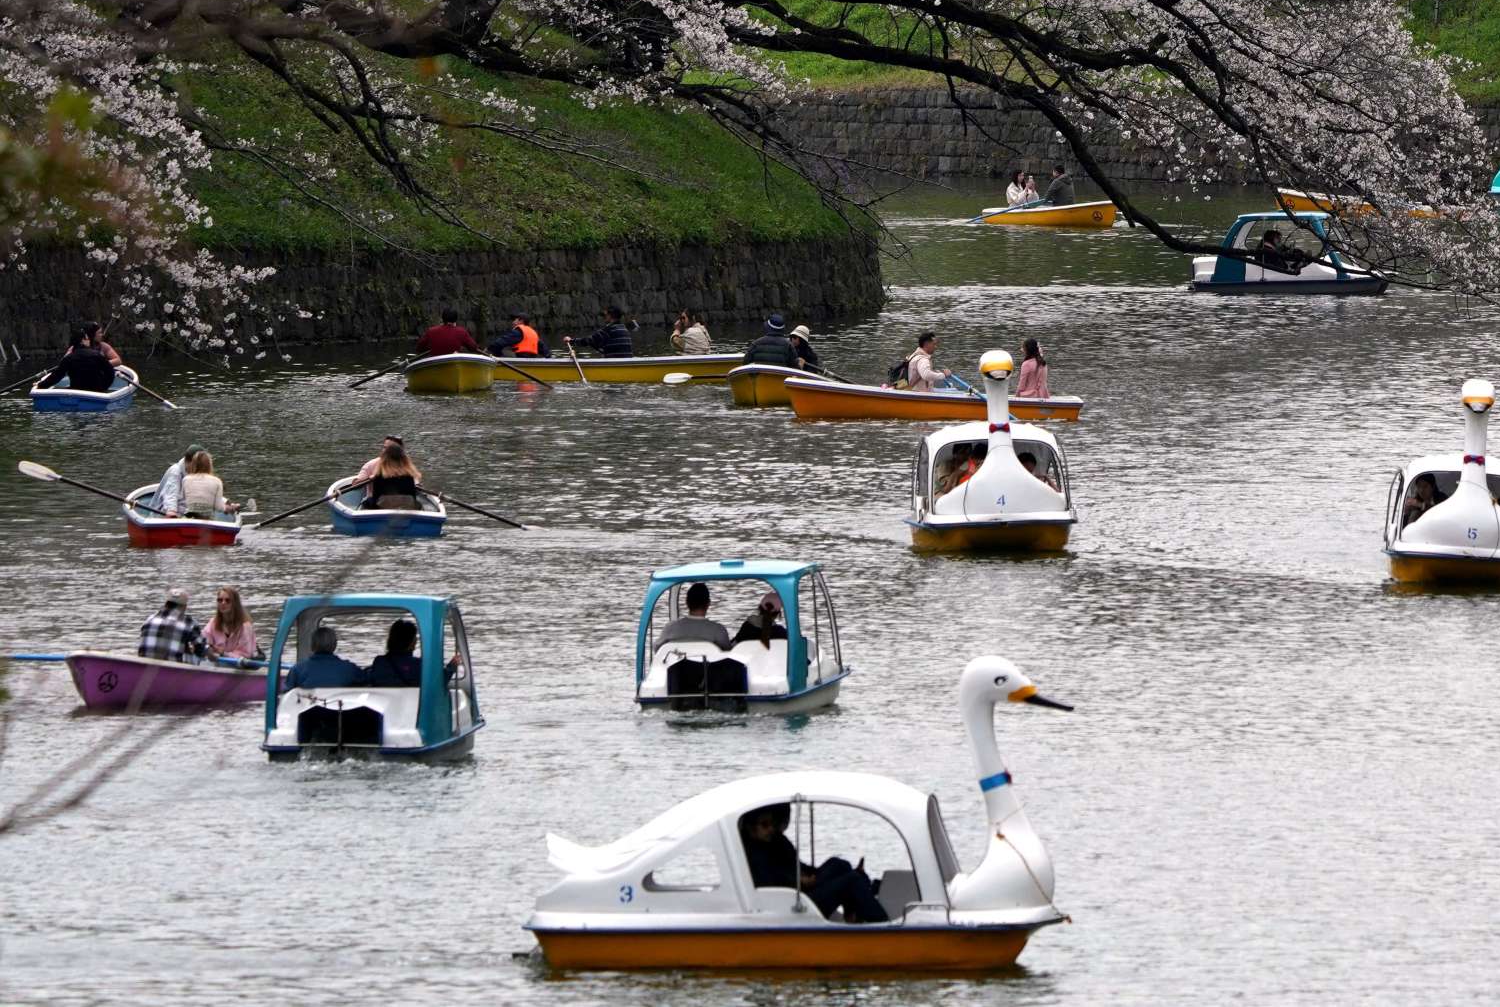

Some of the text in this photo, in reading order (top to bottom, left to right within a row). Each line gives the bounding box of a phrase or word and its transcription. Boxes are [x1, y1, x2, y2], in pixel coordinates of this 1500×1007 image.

[996, 494, 1006, 506] 4
[1468, 527, 1478, 540] 5
[620, 885, 633, 904] 3
